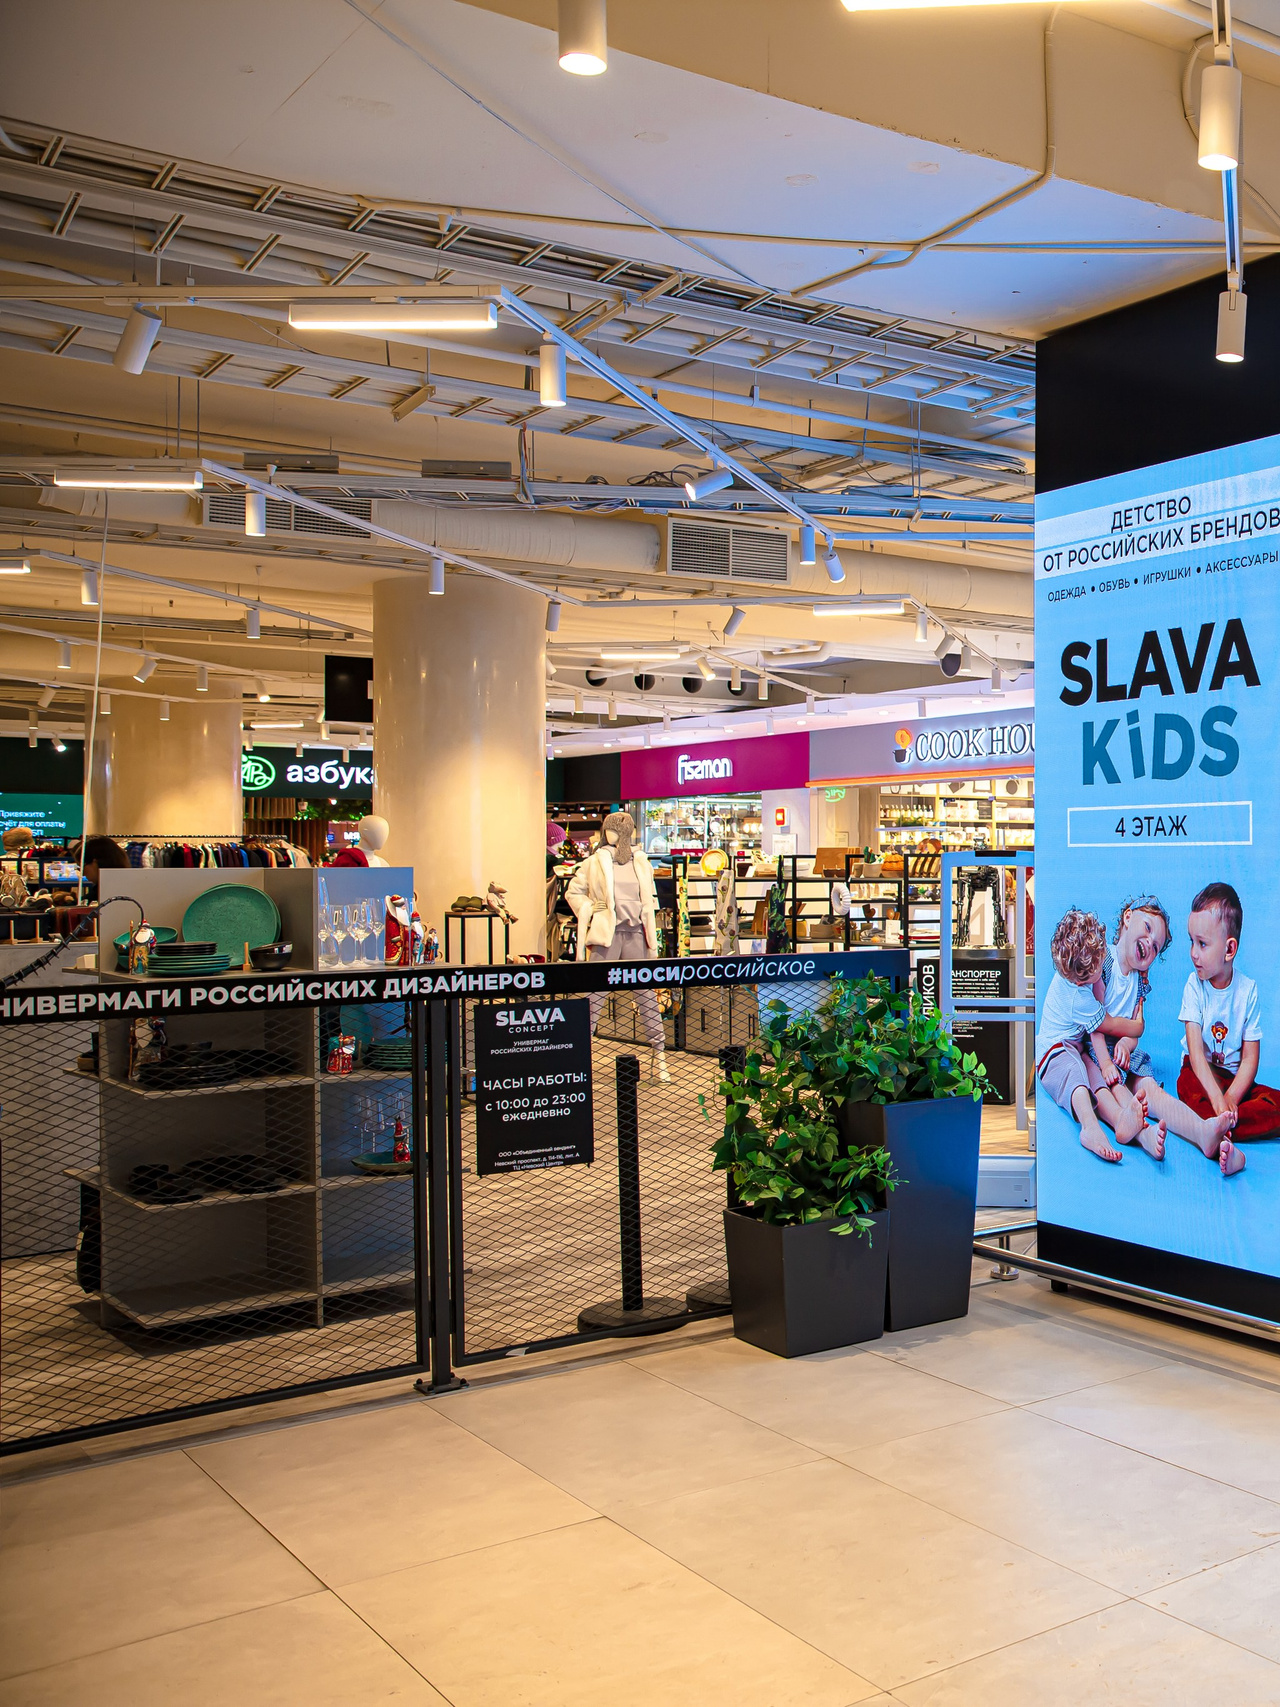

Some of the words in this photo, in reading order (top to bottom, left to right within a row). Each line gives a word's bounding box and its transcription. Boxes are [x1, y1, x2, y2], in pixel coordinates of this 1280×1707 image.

[1111, 496, 1191, 533] ДЕТСТВО
[1043, 552, 1063, 572] ОТ
[1068, 527, 1184, 567] РОССИЙСКИХ
[1190, 508, 1280, 543] БРЕНДОВ
[1047, 585, 1087, 602] ОДЕЖДА
[1099, 578, 1130, 593] ОБУВЬ
[1143, 566, 1191, 585] ИГРУШКИ
[1205, 550, 1279, 574] АКСЕССУАРЫ
[1059, 618, 1261, 706] SLAVA
[915, 728, 986, 762] COOK
[1115, 817, 1126, 837] 4
[1132, 815, 1187, 836] ЭТАЖ
[191, 979, 377, 1006] РОССИЙСКИХ
[383, 971, 545, 999] ДИЗАЙНЕРОВ
[923, 964, 935, 1020] ЛИКОВ
[495, 1007, 566, 1026] SLAVA
[508, 1024, 555, 1034] CONCEPT
[490, 1047, 533, 1055] РОССИЙСКИХ
[533, 1043, 573, 1052] ДИЗАЙНЕРОВ
[513, 1038, 549, 1047] УНИВЕРМАГ
[483, 1077, 524, 1091] ЧАСЫ
[527, 1072, 587, 1088] РАБОТЫ:
[485, 1103, 492, 1111] с
[495, 1098, 530, 1111] 10:00
[533, 1098, 549, 1108] до
[552, 1092, 586, 1105] 23:00
[502, 1107, 571, 1122] ежедневно
